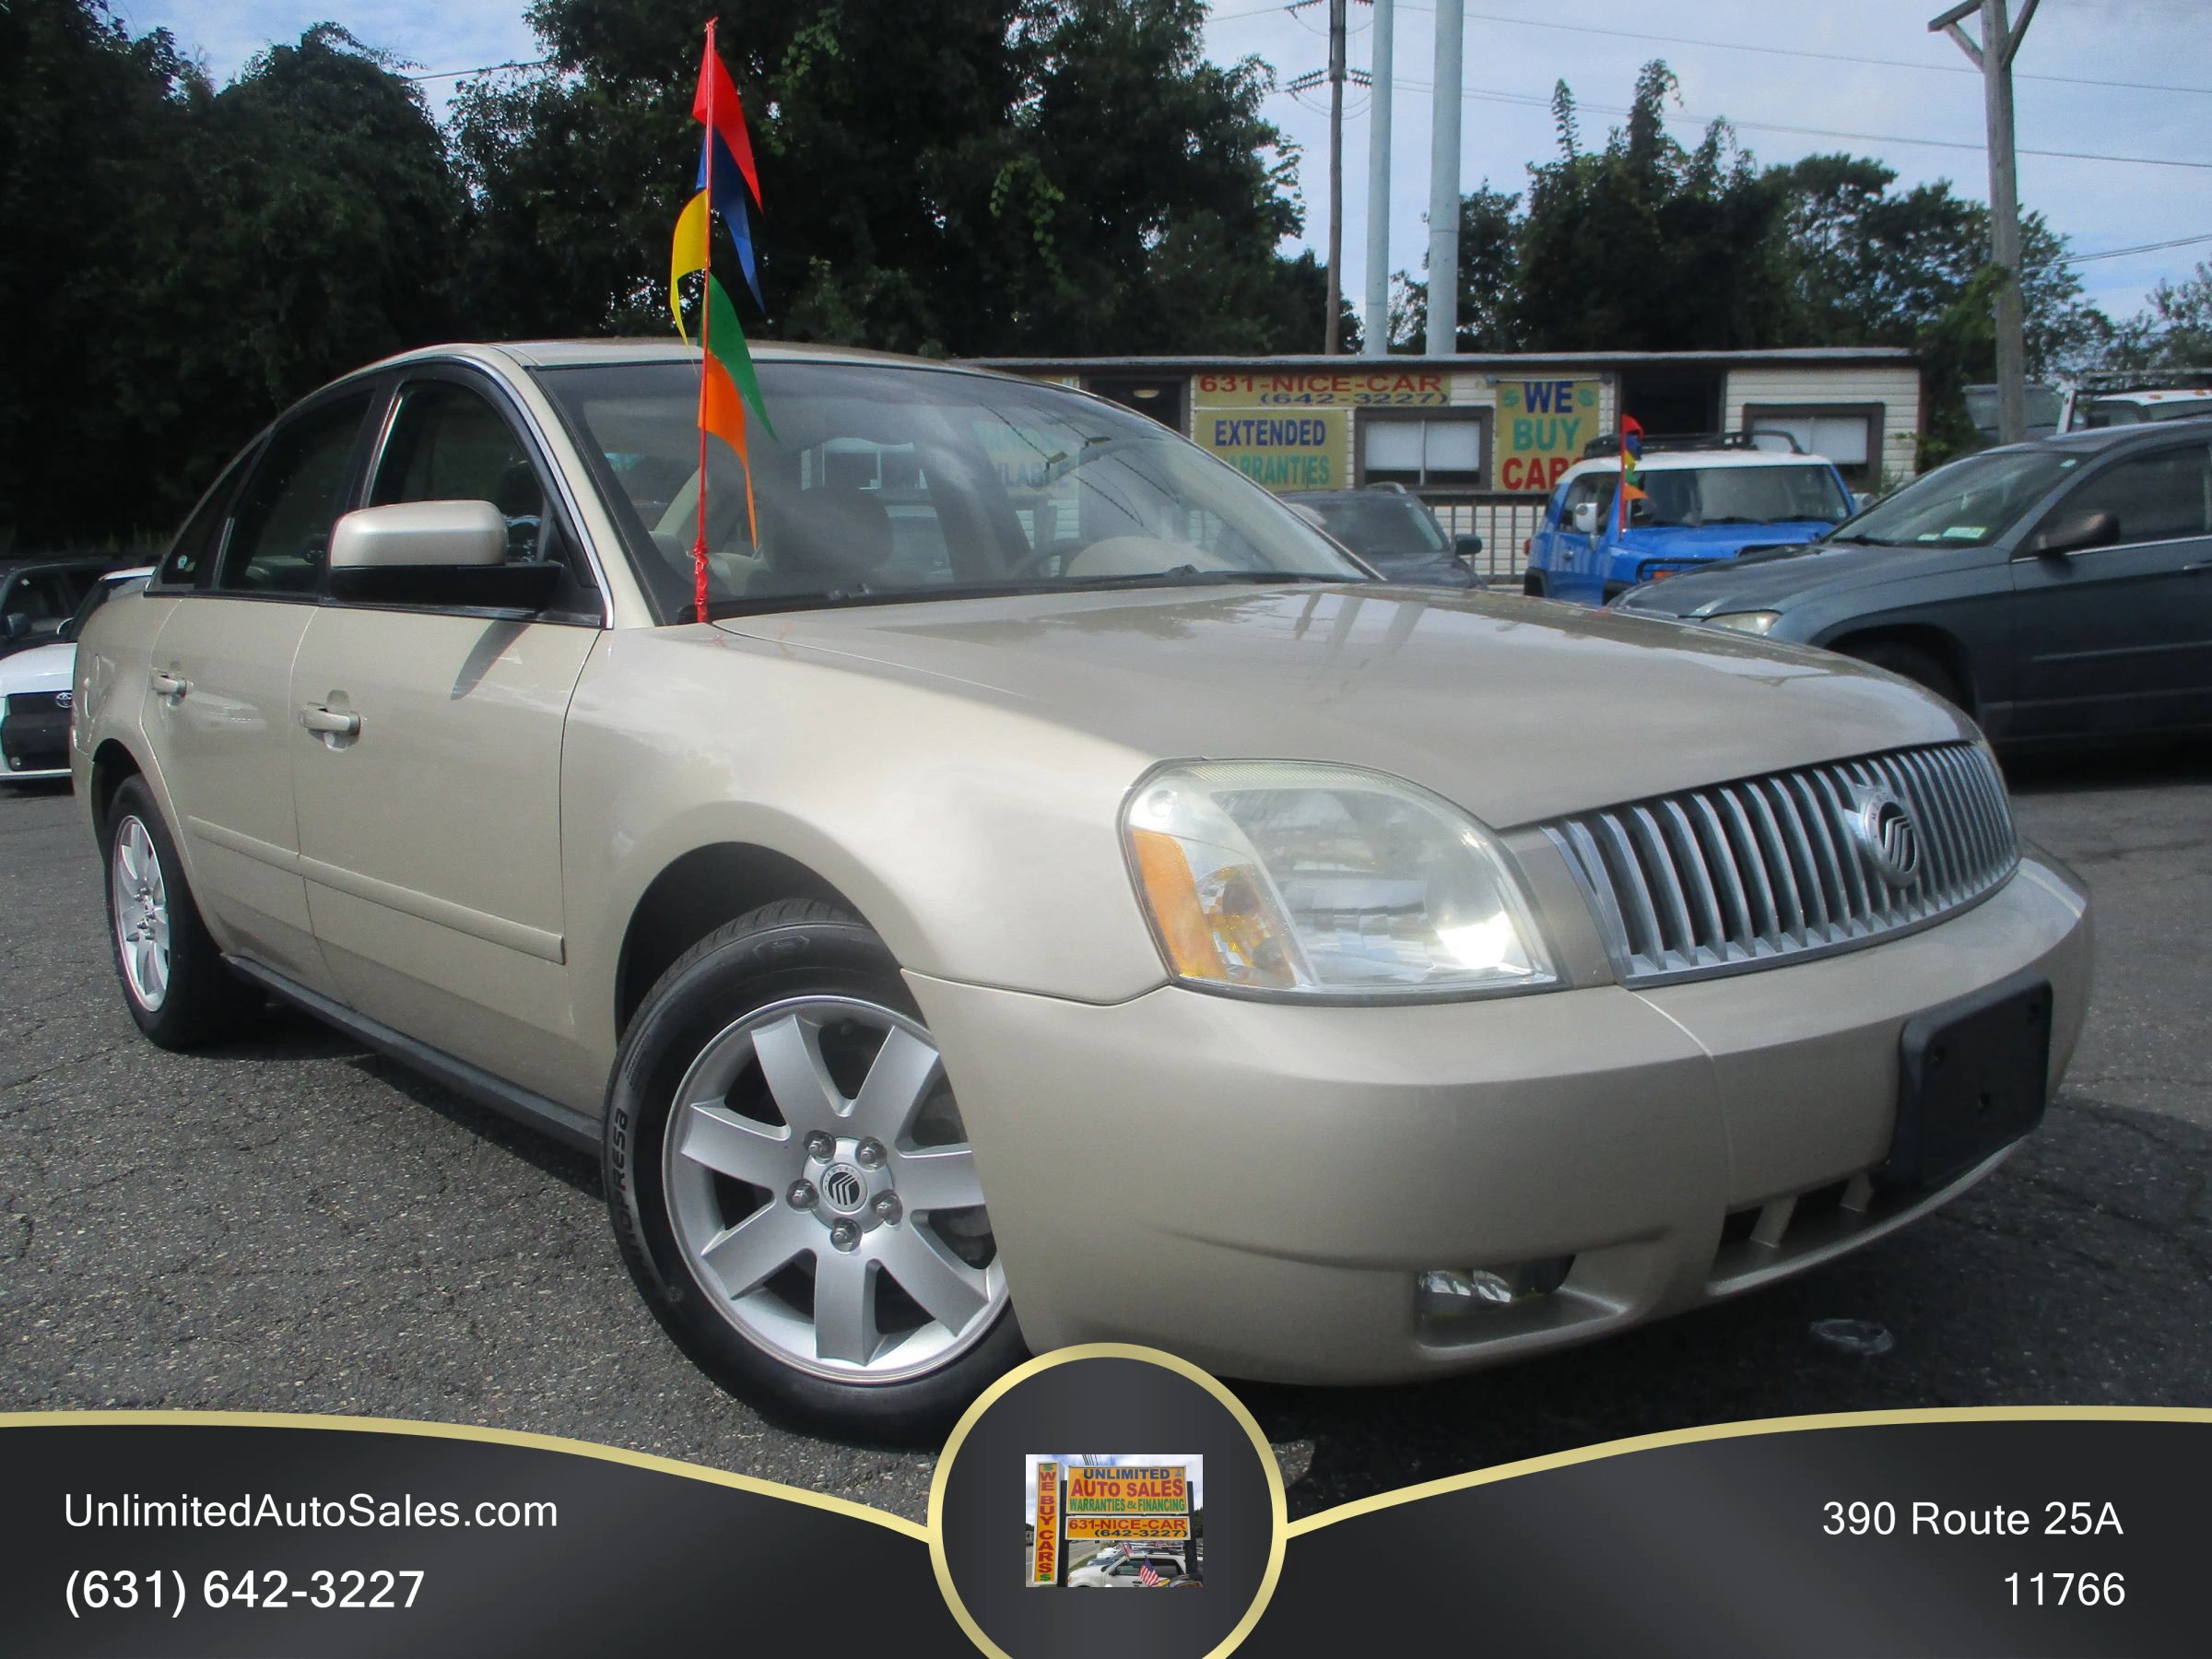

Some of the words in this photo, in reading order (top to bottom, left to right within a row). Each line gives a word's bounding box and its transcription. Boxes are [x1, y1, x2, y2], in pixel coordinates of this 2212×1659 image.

[1199, 374, 1443, 393] 631-NICE-CAR
[1260, 393, 1449, 405] (642-3227)
[1524, 381, 1574, 413] WE
[1214, 419, 1327, 447] EXTENDED
[1512, 418, 1582, 452] BUY
[1224, 454, 1330, 486] RRANTIES
[1502, 457, 1584, 490] CAR
